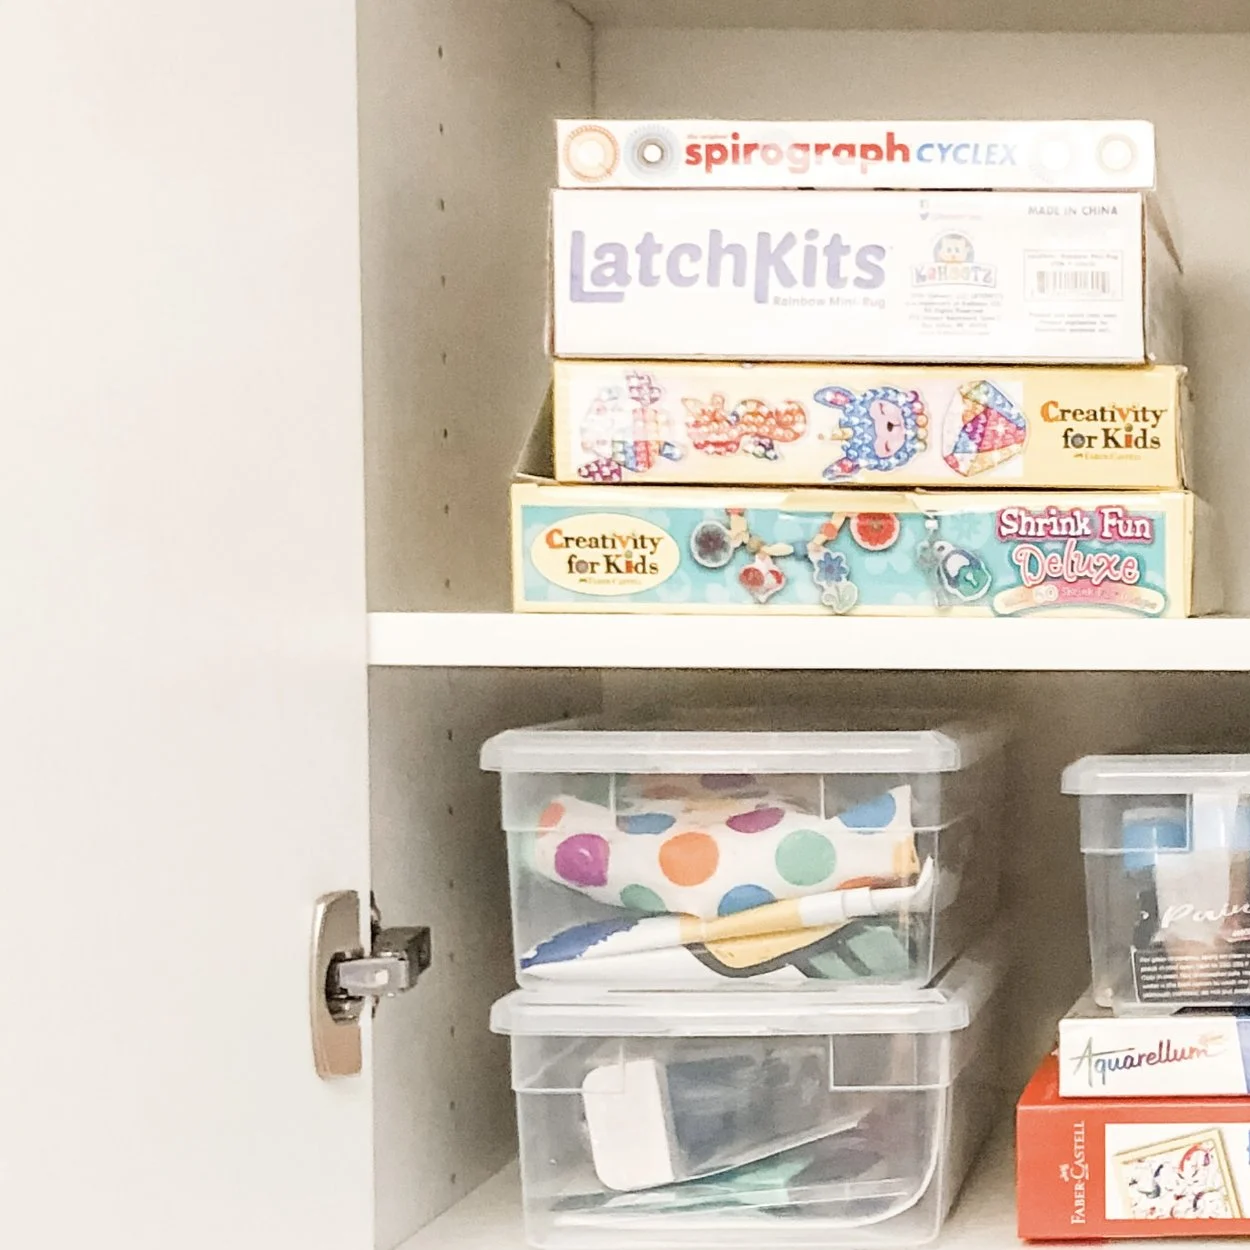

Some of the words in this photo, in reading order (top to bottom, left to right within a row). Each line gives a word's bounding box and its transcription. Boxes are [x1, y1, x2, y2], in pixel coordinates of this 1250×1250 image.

[684, 132, 910, 174] spirograph
[917, 143, 1016, 165] CYCLEX
[1028, 206, 1060, 216] MADE
[1064, 206, 1077, 216] IN
[1082, 206, 1118, 216] CHINA
[570, 228, 886, 304] LatchKits
[773, 296, 825, 307] Rainbow
[862, 297, 886, 309] Rug
[1040, 400, 1168, 428] Creativity
[1062, 428, 1098, 448] for
[1102, 423, 1161, 449] Kids
[1000, 506, 1091, 536] Shrink
[1101, 508, 1151, 538] Fun
[546, 528, 664, 554] Creativity
[568, 554, 600, 574] for
[603, 551, 659, 574] Kids
[1013, 538, 1140, 587] Deluxe
[1070, 1037, 1212, 1087] Aquarellum
[1070, 1120, 1089, 1224] FABER-CASTELL
